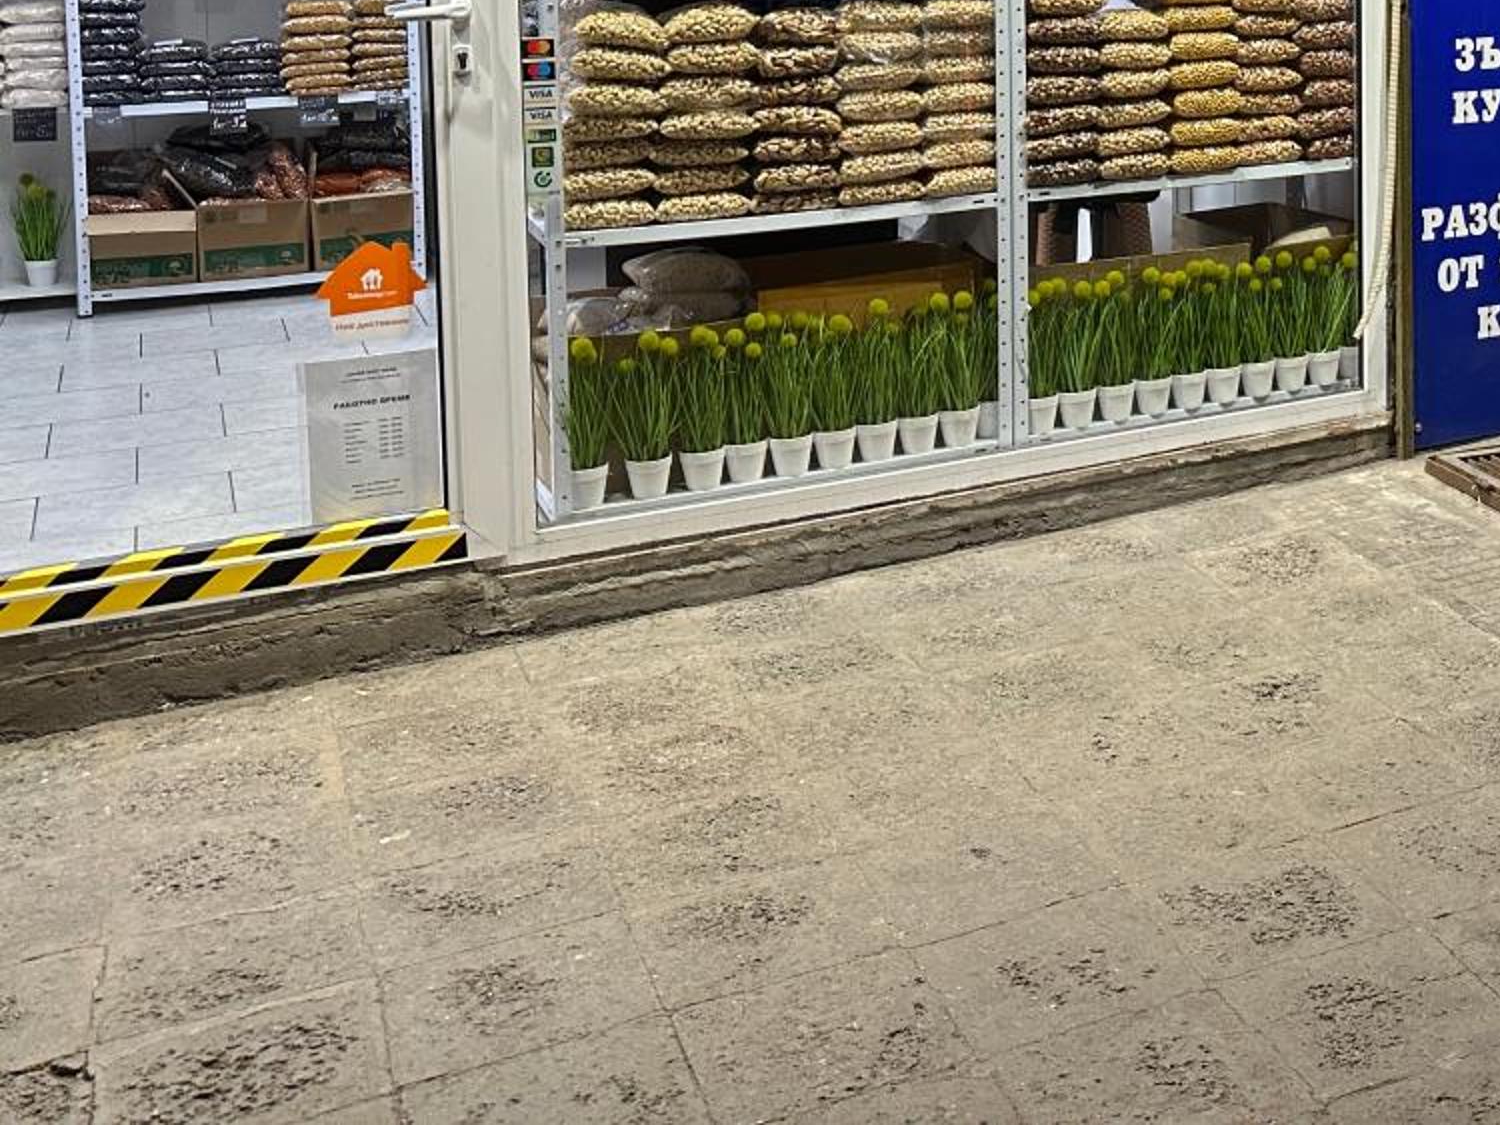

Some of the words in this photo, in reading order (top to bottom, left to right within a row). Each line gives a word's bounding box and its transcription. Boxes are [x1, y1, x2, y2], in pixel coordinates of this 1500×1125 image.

[529, 90, 553, 99] VISA
[529, 111, 553, 120] VISA
[1437, 255, 1484, 292] ОТ
